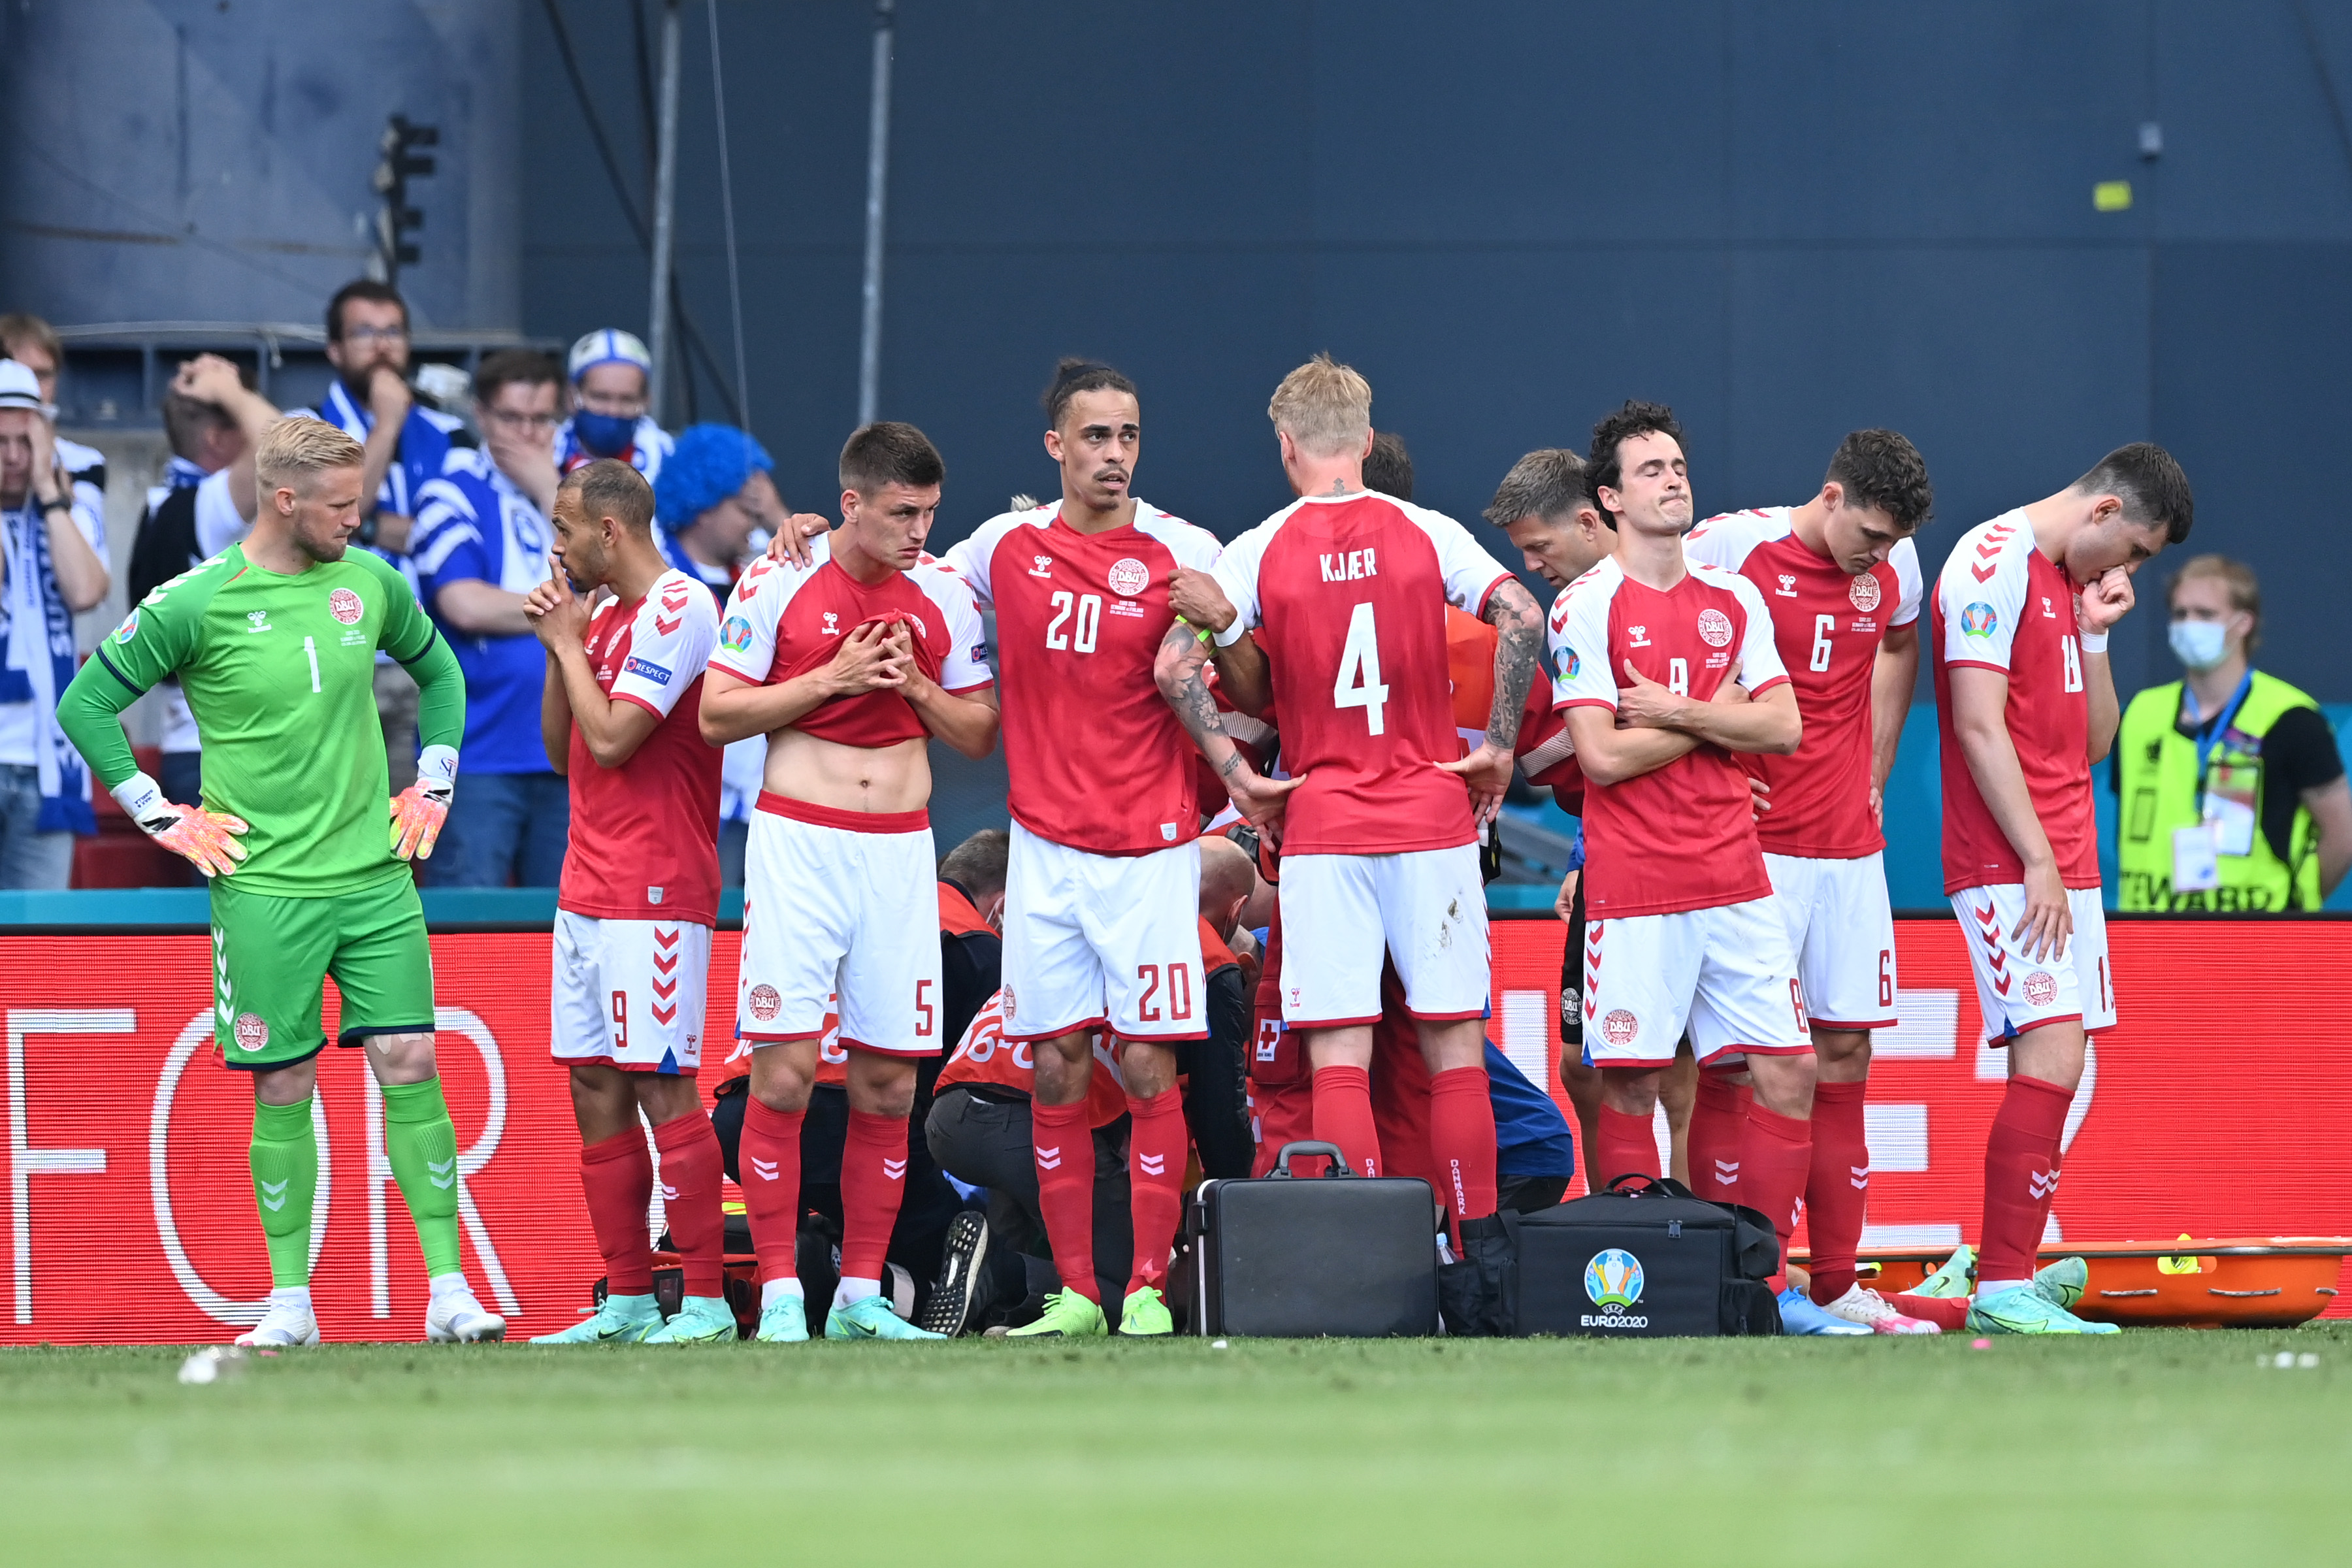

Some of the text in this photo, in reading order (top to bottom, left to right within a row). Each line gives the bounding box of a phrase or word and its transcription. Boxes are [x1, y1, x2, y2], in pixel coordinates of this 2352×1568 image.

[1117, 571, 1140, 583] DBU
[1320, 547, 1377, 582] KJÆR
[335, 600, 355, 612] DBU
[1855, 585, 1873, 597] DBU
[1046, 591, 1102, 653] 20
[1705, 621, 1725, 632] DBU
[1810, 614, 1835, 672] 6
[304, 636, 321, 693] 1
[636, 662, 670, 681] RESPECT
[1334, 602, 1389, 736] 4
[1137, 962, 1192, 1022] 20
[1879, 949, 1892, 1007] 6
[2029, 982, 2051, 995] DBU
[612, 990, 628, 1047] 9
[755, 996, 775, 1008] DBU
[915, 979, 932, 1036] 5
[1564, 1000, 1578, 1011] DBU
[1789, 978, 1808, 1034] 8
[241, 1024, 261, 1036] DBU
[1609, 1021, 1631, 1032] DBU
[6, 1006, 523, 1326] FOR
[1450, 1159, 1466, 1215] DANMARK
[1603, 1305, 1624, 1315] UEFA
